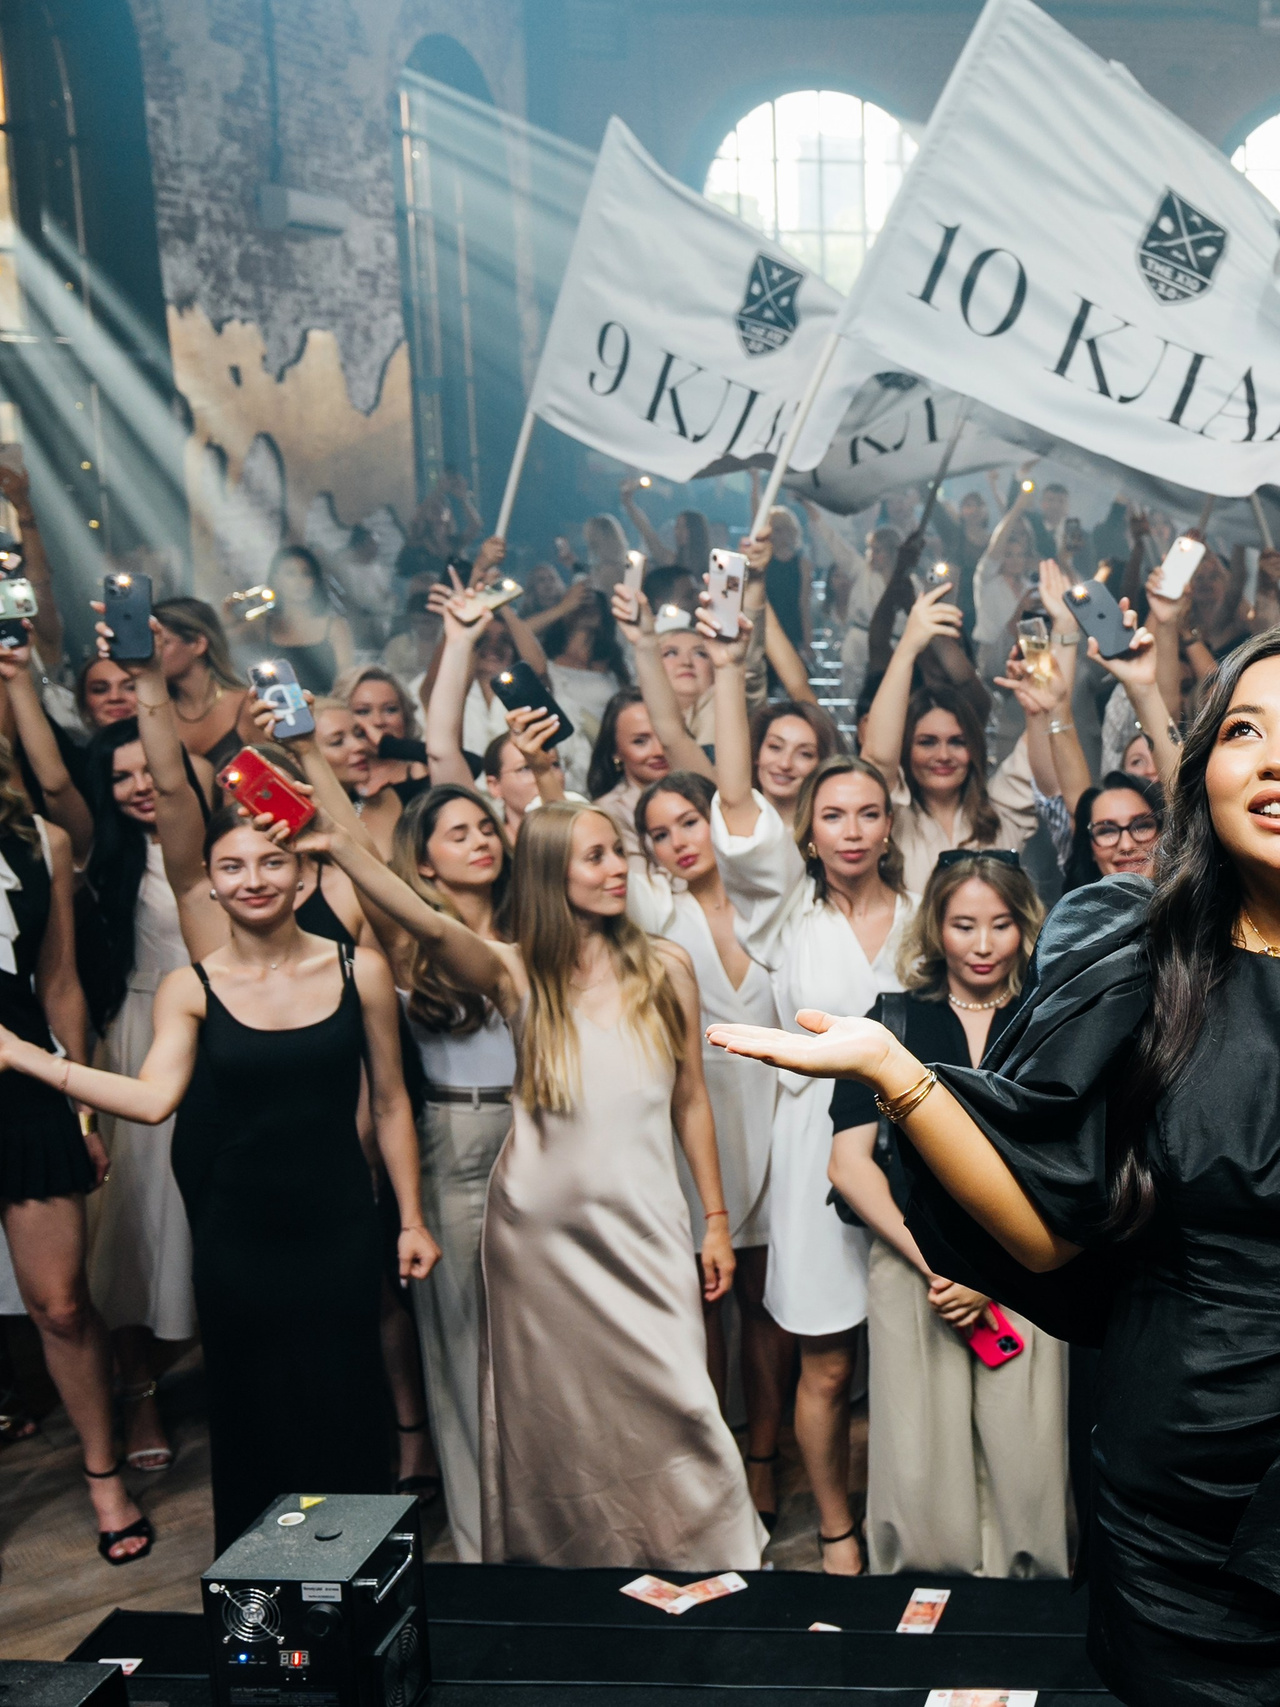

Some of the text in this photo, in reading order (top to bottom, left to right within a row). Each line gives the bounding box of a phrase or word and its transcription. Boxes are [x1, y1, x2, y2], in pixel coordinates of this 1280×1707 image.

[907, 221, 1028, 338] 10
[589, 320, 800, 456] 9 КЛА
